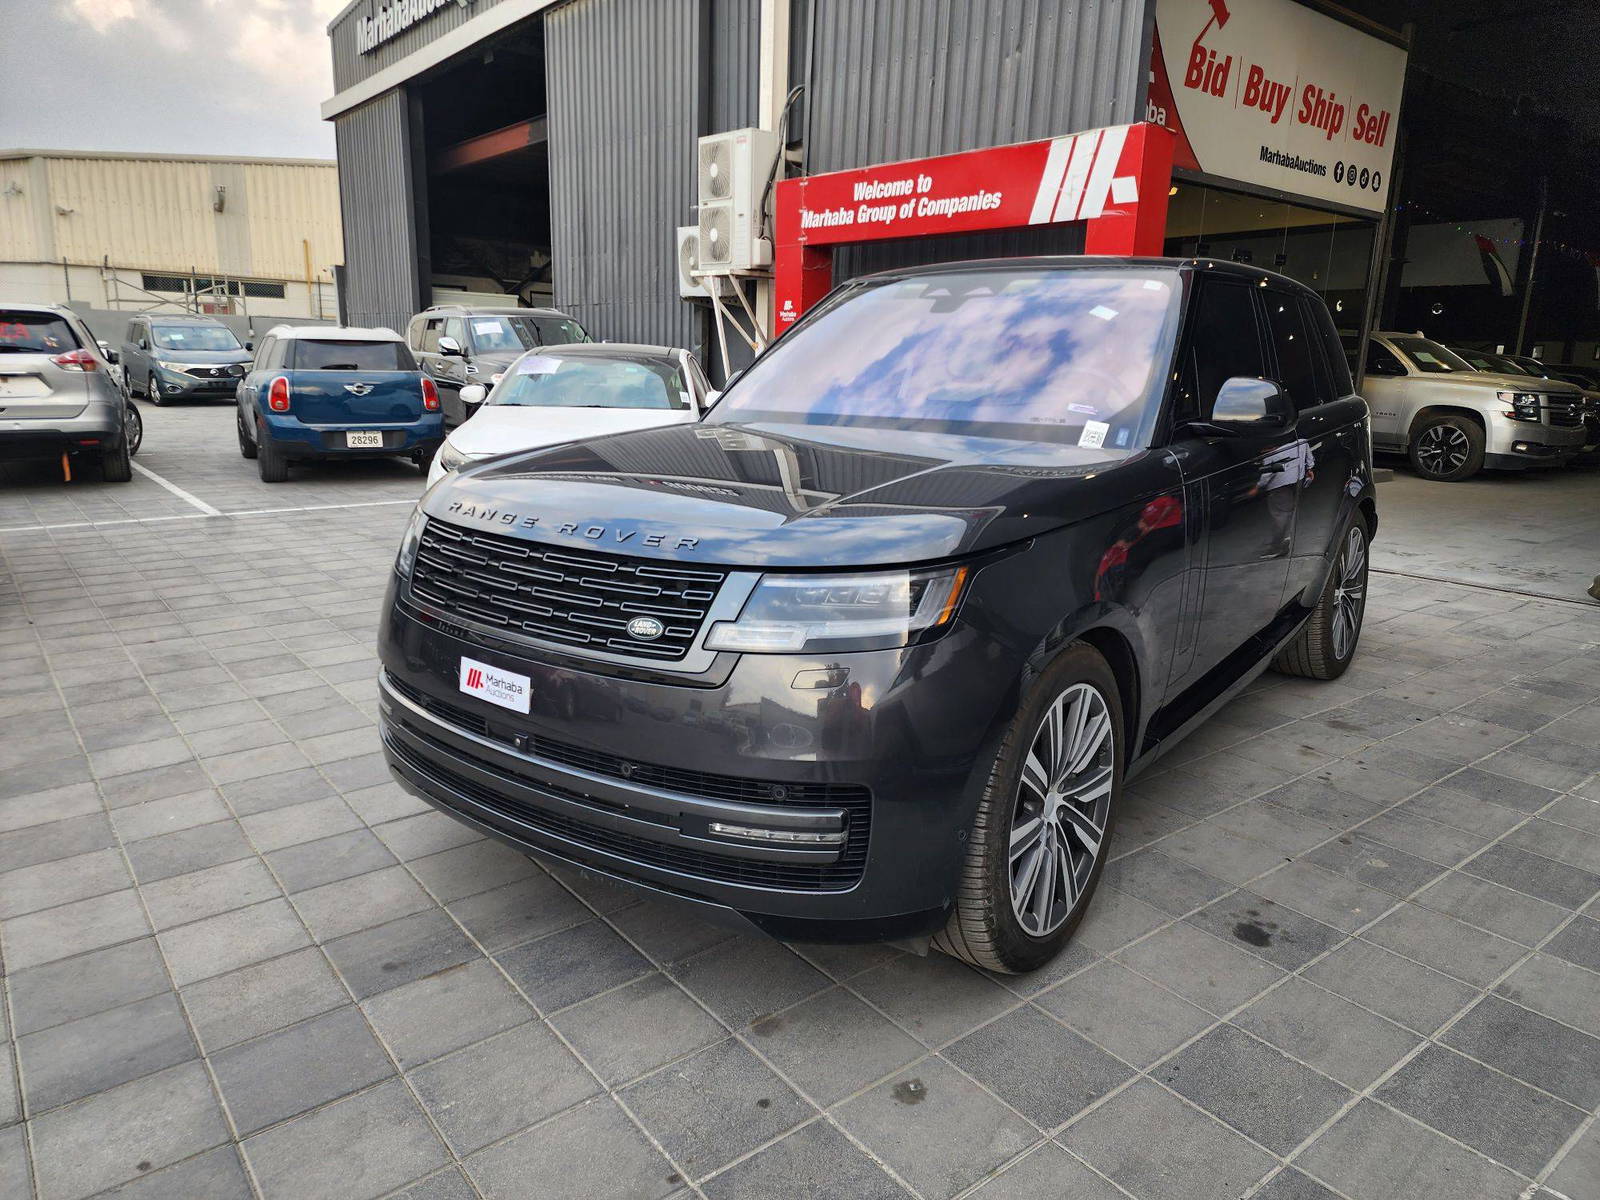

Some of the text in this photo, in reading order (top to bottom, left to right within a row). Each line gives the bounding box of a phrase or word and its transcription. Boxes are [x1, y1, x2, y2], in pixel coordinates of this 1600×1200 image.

[1184, 43, 1391, 148] Bid Buy Ship Sell
[1259, 145, 1327, 177] MarhabaAuctions
[853, 174, 932, 201] Welcome to
[801, 190, 1002, 229] Marhaba Group of Companies
[352, 436, 378, 444] 28296
[448, 502, 700, 551] RANGE ROVER
[486, 673, 523, 695] Marhaba
[486, 685, 515, 703] Auctions
